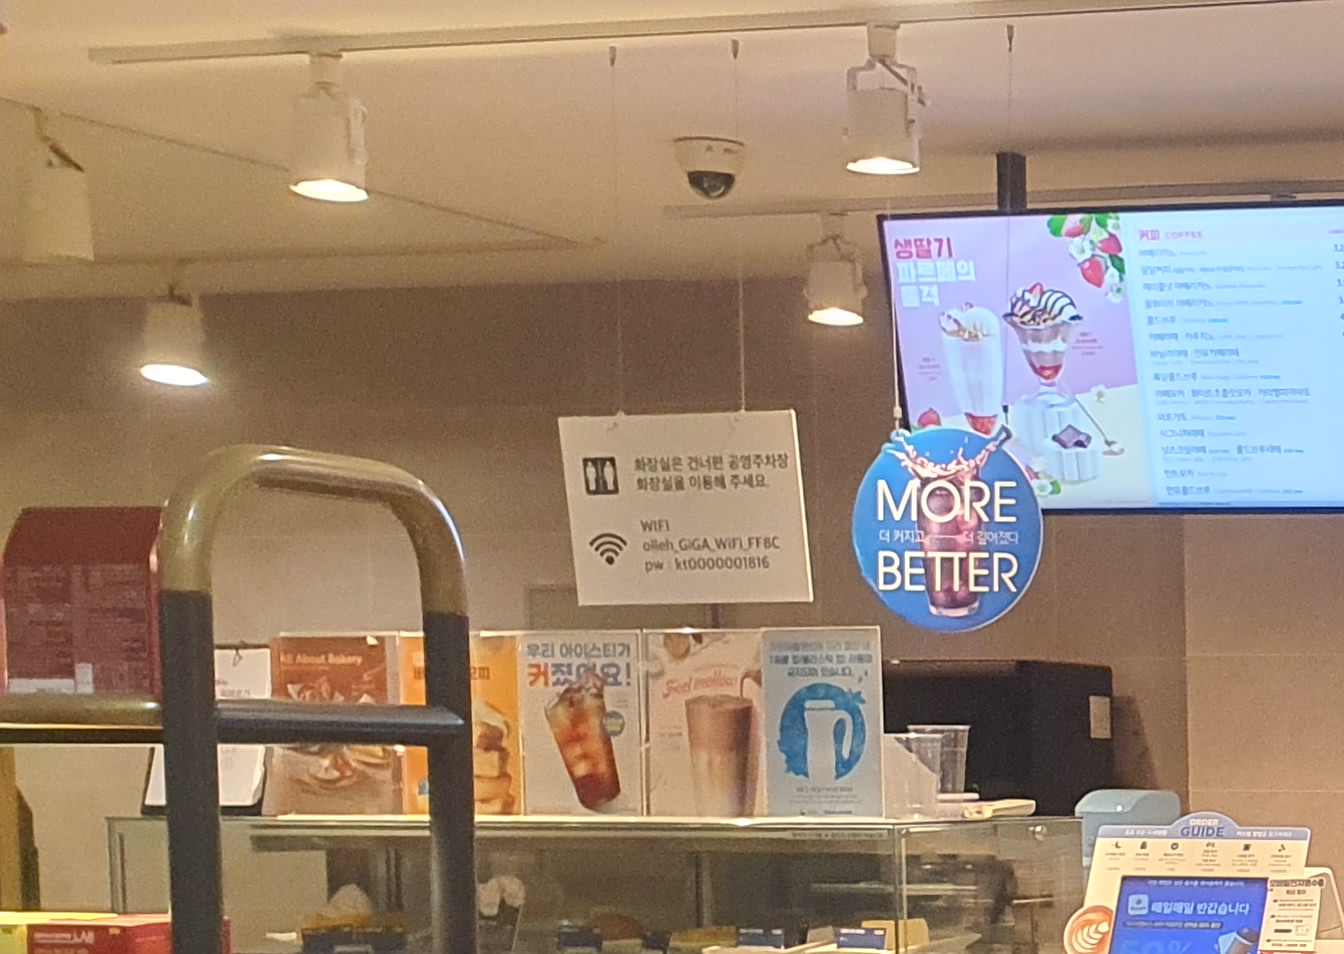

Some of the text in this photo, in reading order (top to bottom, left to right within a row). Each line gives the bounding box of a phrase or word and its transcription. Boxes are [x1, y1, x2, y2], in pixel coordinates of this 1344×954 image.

[1139, 230, 1203, 241] 커피 COFFEE
[894, 237, 953, 259] 생딸기
[634, 453, 789, 473] 화장실은 건너편 공영주차장
[636, 475, 686, 492] 화장실을
[689, 474, 727, 490] 이용해
[876, 479, 1017, 523] MORE
[640, 519, 670, 532] WIFI
[879, 529, 890, 543] 더
[893, 530, 925, 544] 커지고
[963, 530, 974, 543] 더
[644, 560, 664, 573] pw
[877, 550, 1019, 593] BETTER
[526, 642, 631, 659] 우리 아이스티가
[328, 654, 363, 666] Bakery
[1180, 826, 1225, 838] GUIDE
[1151, 902, 1250, 915] 매일매일 반갑습니다
